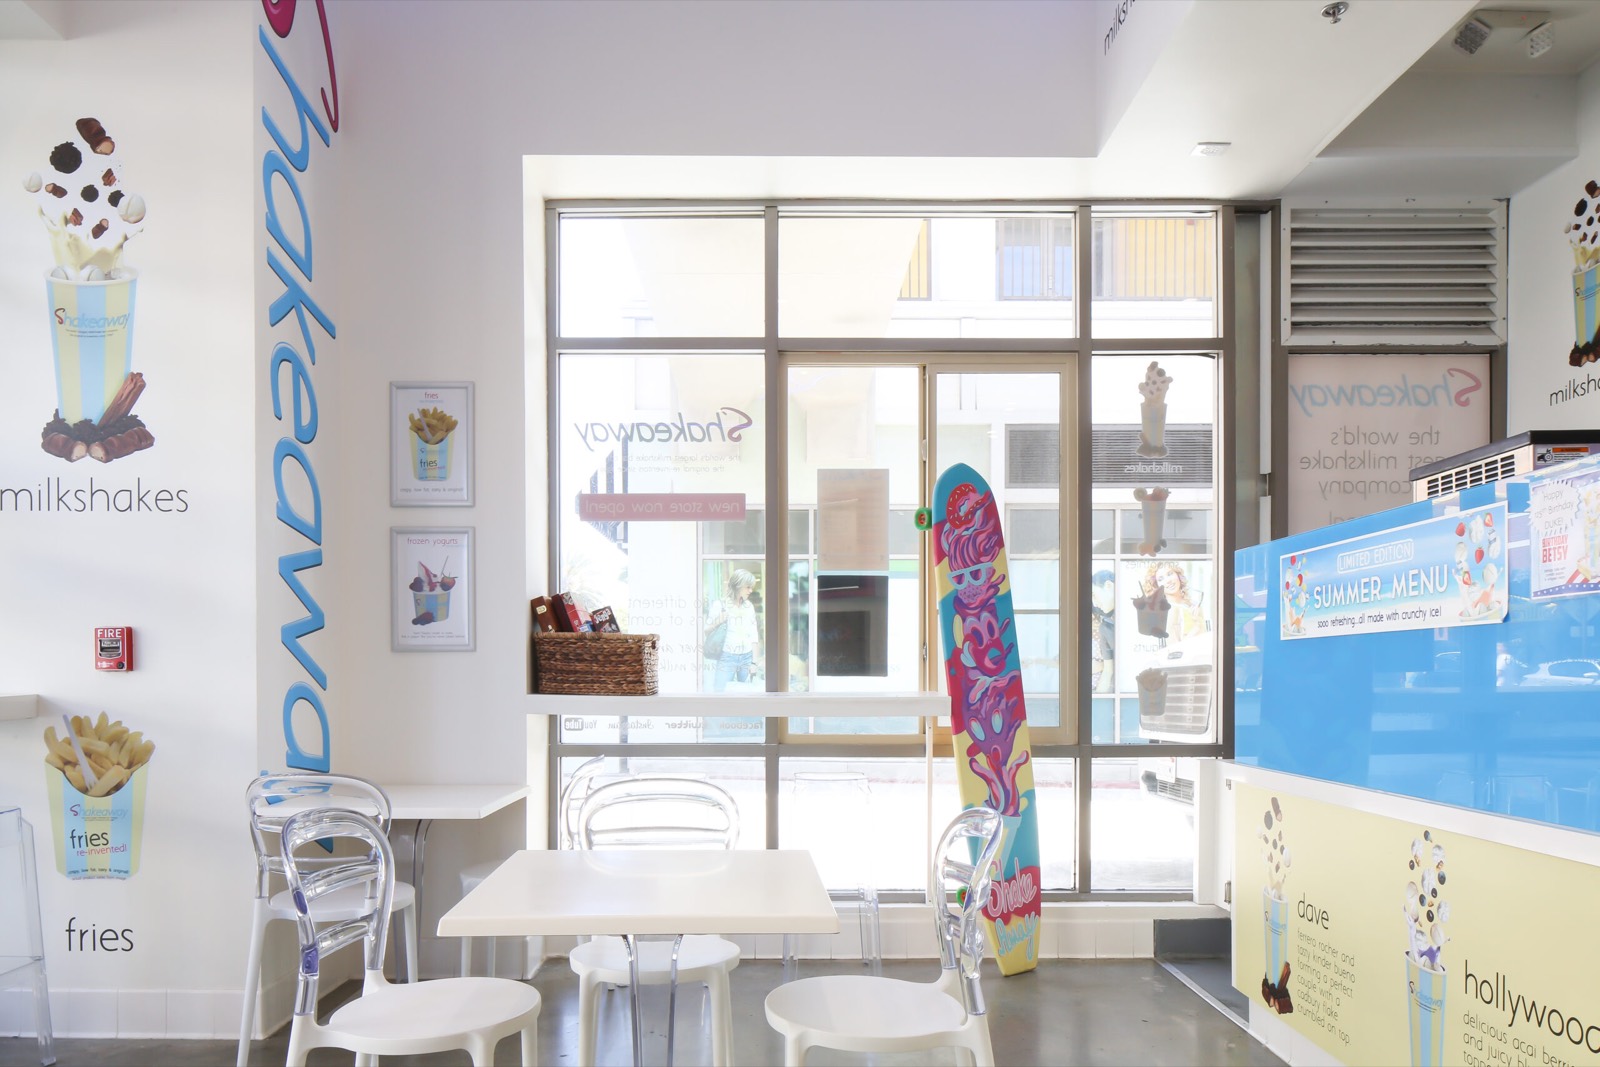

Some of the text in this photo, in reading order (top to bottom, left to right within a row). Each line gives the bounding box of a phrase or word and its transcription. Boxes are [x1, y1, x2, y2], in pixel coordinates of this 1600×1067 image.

[54, 307, 130, 329] Shakeaway
[424, 391, 439, 399] fries
[1550, 373, 1600, 406] milksh
[420, 458, 438, 468] fries
[0, 477, 189, 512] milkshakes
[407, 537, 429, 545] frozen
[433, 537, 458, 547] yogurts
[1339, 542, 1411, 571] LIMITED EDITION
[1542, 545, 1568, 563] BETSY
[1313, 564, 1448, 609] SUMMER MENU
[1317, 619, 1329, 629] sooo
[1367, 611, 1384, 623] made
[1386, 609, 1400, 622] with
[1401, 606, 1427, 623] crunchy
[97, 628, 122, 638] FIRE
[70, 829, 109, 849] fries
[77, 843, 127, 856] re-invented!
[987, 857, 1037, 917] Shake
[1297, 892, 1330, 930] dave
[65, 917, 134, 952] fries
[1341, 952, 1354, 967] and
[1334, 960, 1356, 983] bueno
[1335, 997, 1340, 1007] a
[1327, 1022, 1337, 1035] on
[1463, 1010, 1508, 1045] delicious
[1512, 1037, 1537, 1058] acai
[1463, 1032, 1483, 1051] and
[1486, 1045, 1512, 1067] juicy
